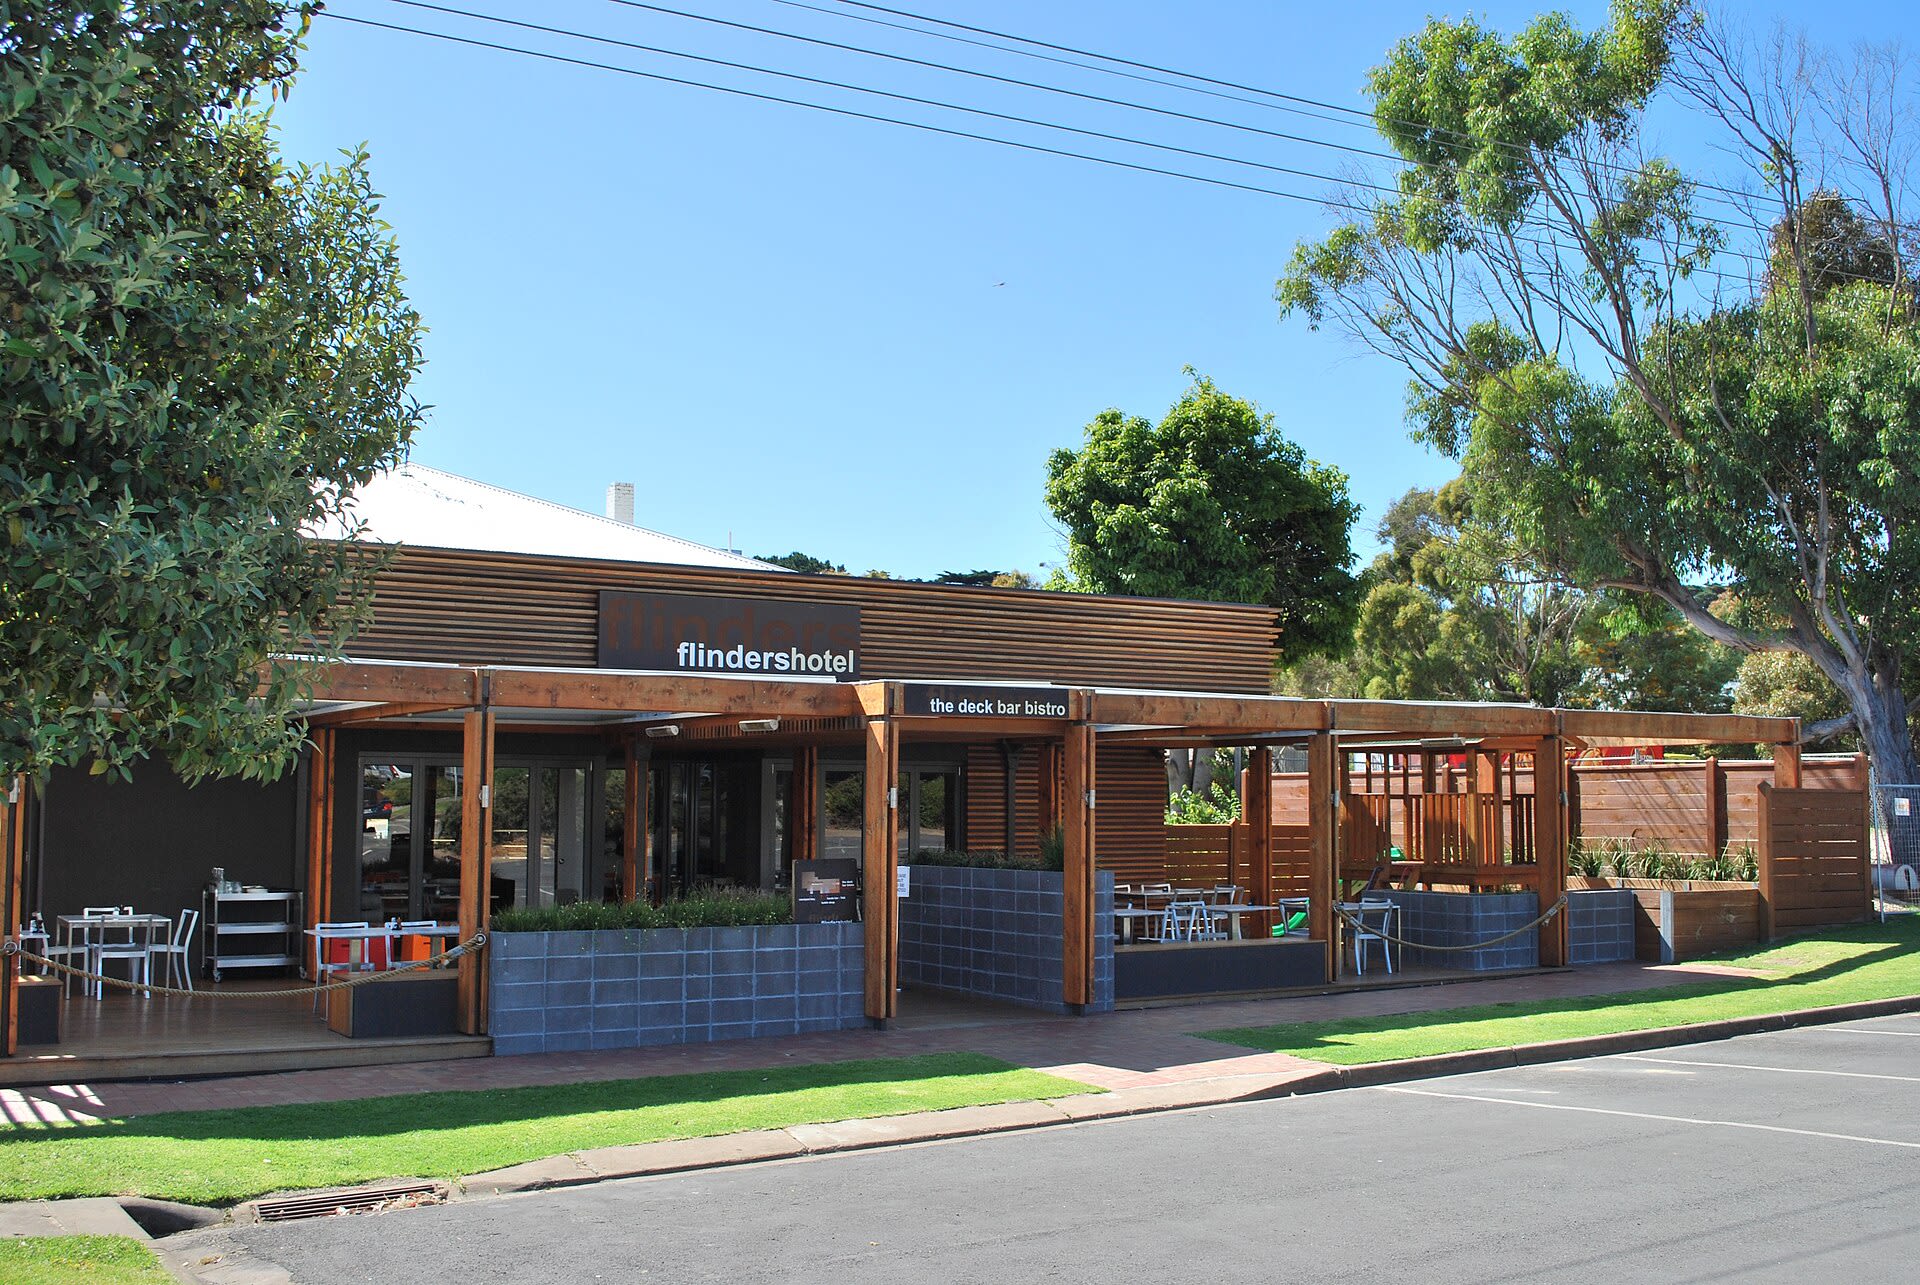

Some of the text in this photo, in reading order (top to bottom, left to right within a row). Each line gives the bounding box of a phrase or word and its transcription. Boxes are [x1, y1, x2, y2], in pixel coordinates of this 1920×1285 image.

[603, 596, 856, 653] flinders
[677, 641, 854, 673] flindershotel
[930, 698, 1065, 715] the deck bar bistro
